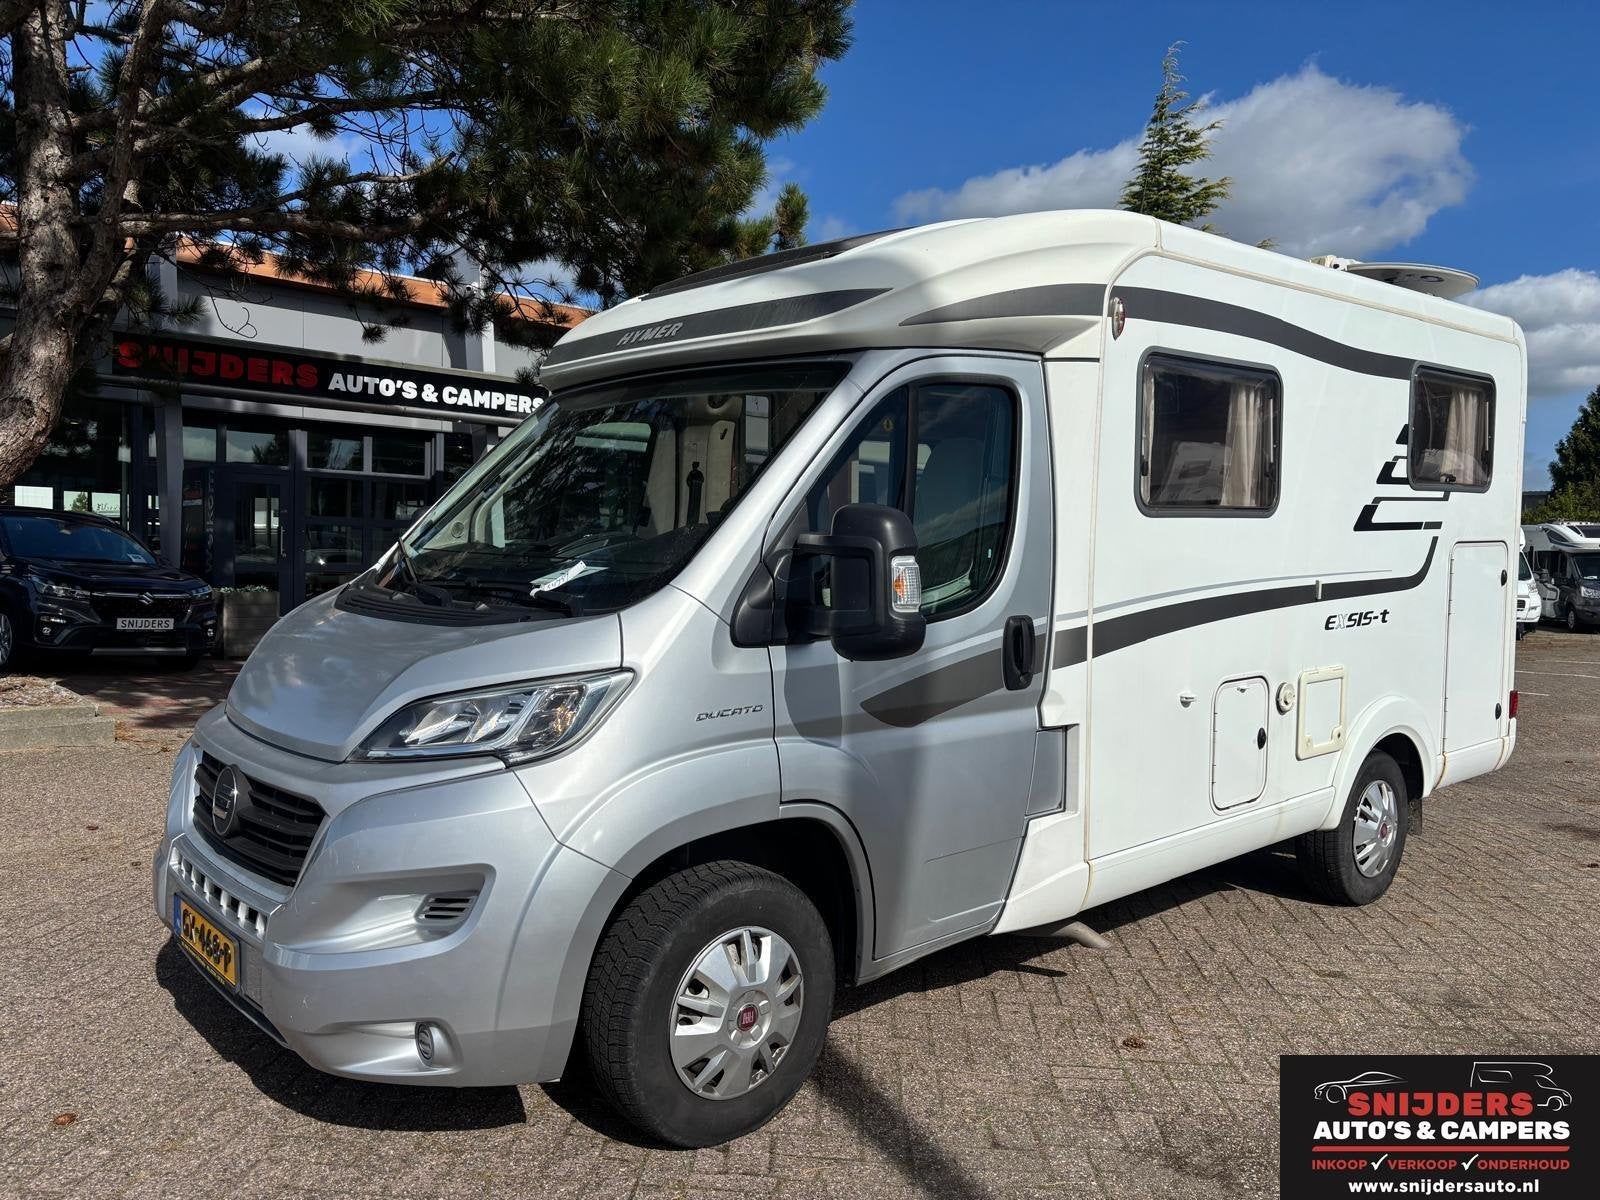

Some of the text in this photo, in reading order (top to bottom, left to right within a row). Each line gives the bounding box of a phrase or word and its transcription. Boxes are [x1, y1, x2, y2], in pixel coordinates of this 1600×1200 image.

[616, 322, 684, 347] HYMER
[328, 372, 418, 398] AUTO'S
[421, 383, 439, 403] &
[442, 386, 545, 414] CAMPERS
[121, 619, 170, 628] SNIJDERS
[695, 704, 763, 722] DUCATO
